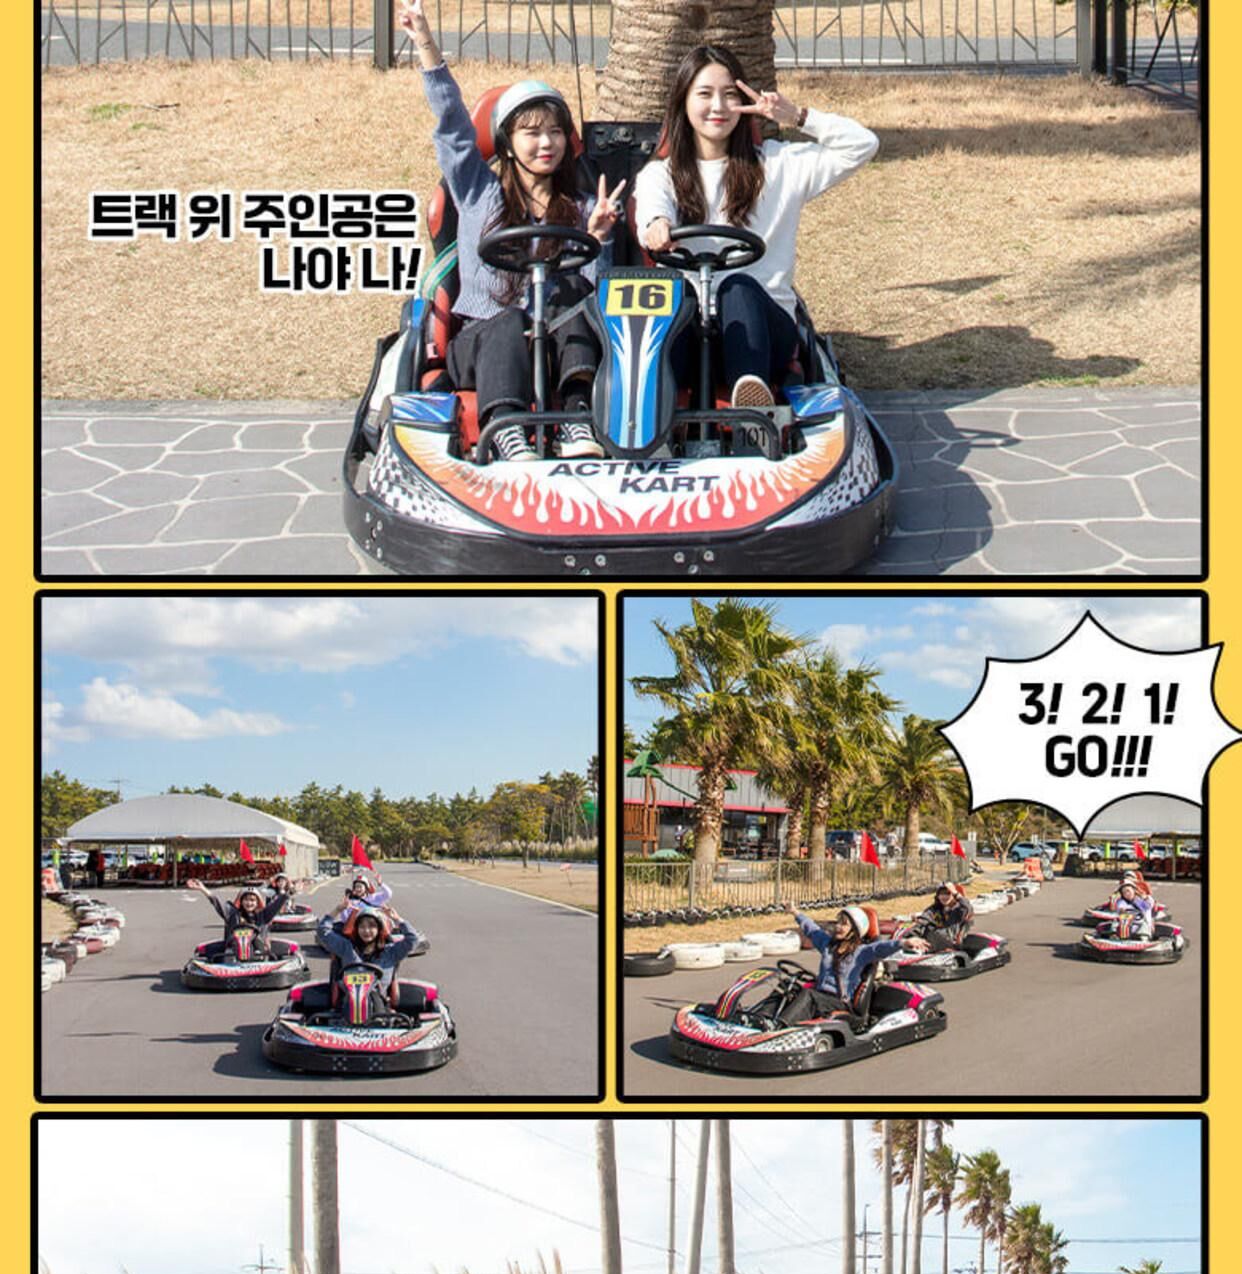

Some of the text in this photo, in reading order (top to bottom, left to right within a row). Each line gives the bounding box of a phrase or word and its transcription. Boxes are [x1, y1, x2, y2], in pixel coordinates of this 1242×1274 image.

[614, 284, 666, 309] 16
[548, 460, 682, 477] ACTIVE
[619, 475, 720, 494] KART
